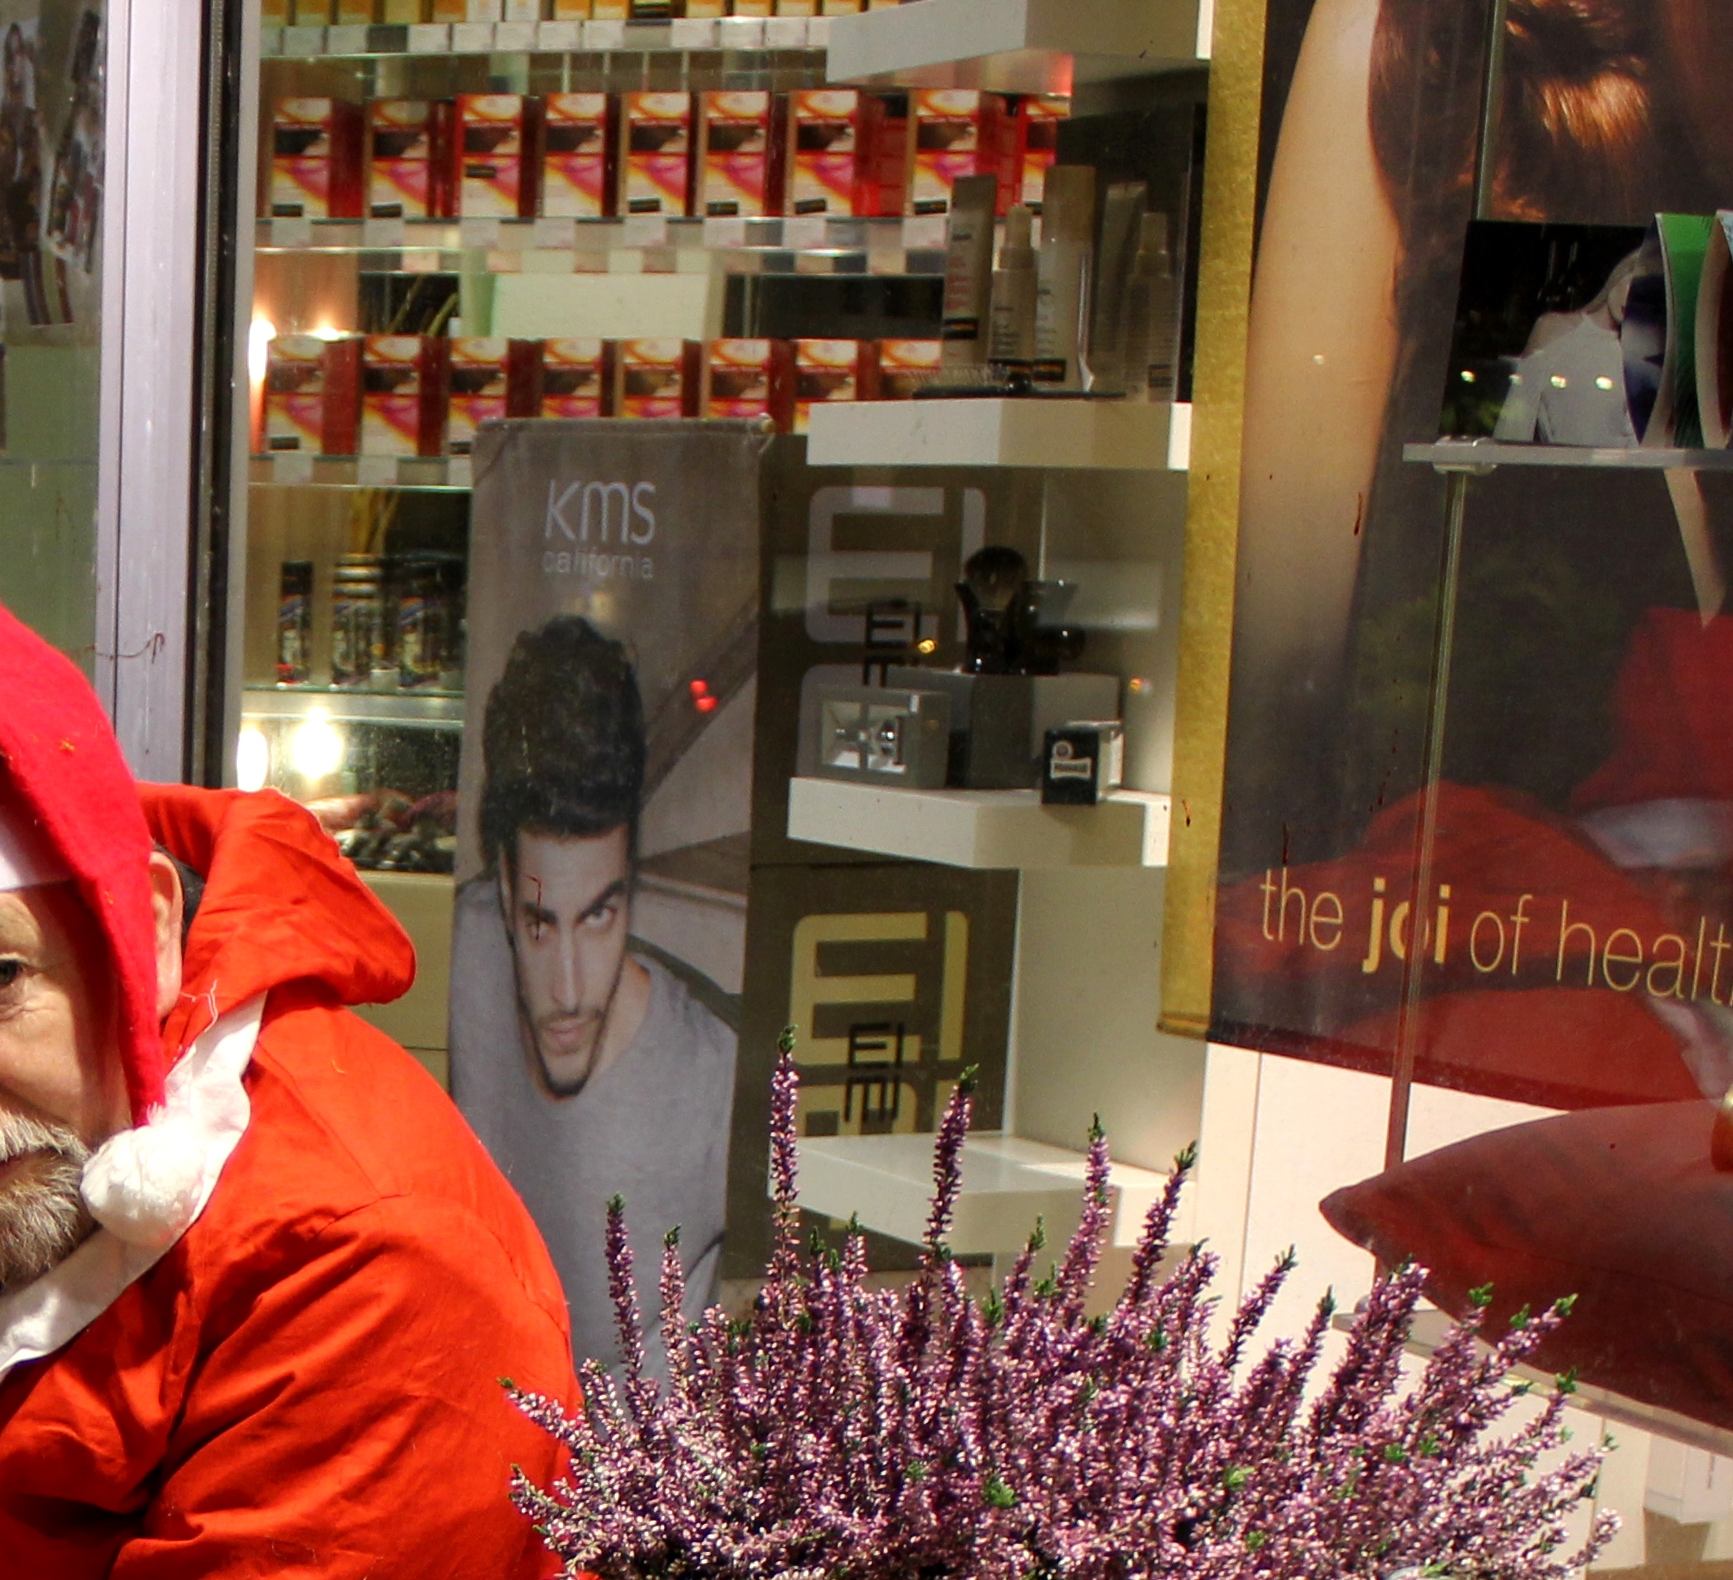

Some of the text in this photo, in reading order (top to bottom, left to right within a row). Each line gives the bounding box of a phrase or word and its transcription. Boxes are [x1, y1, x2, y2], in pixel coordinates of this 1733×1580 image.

[542, 547, 654, 580] california
[1259, 866, 1733, 1007] the joi of healt
